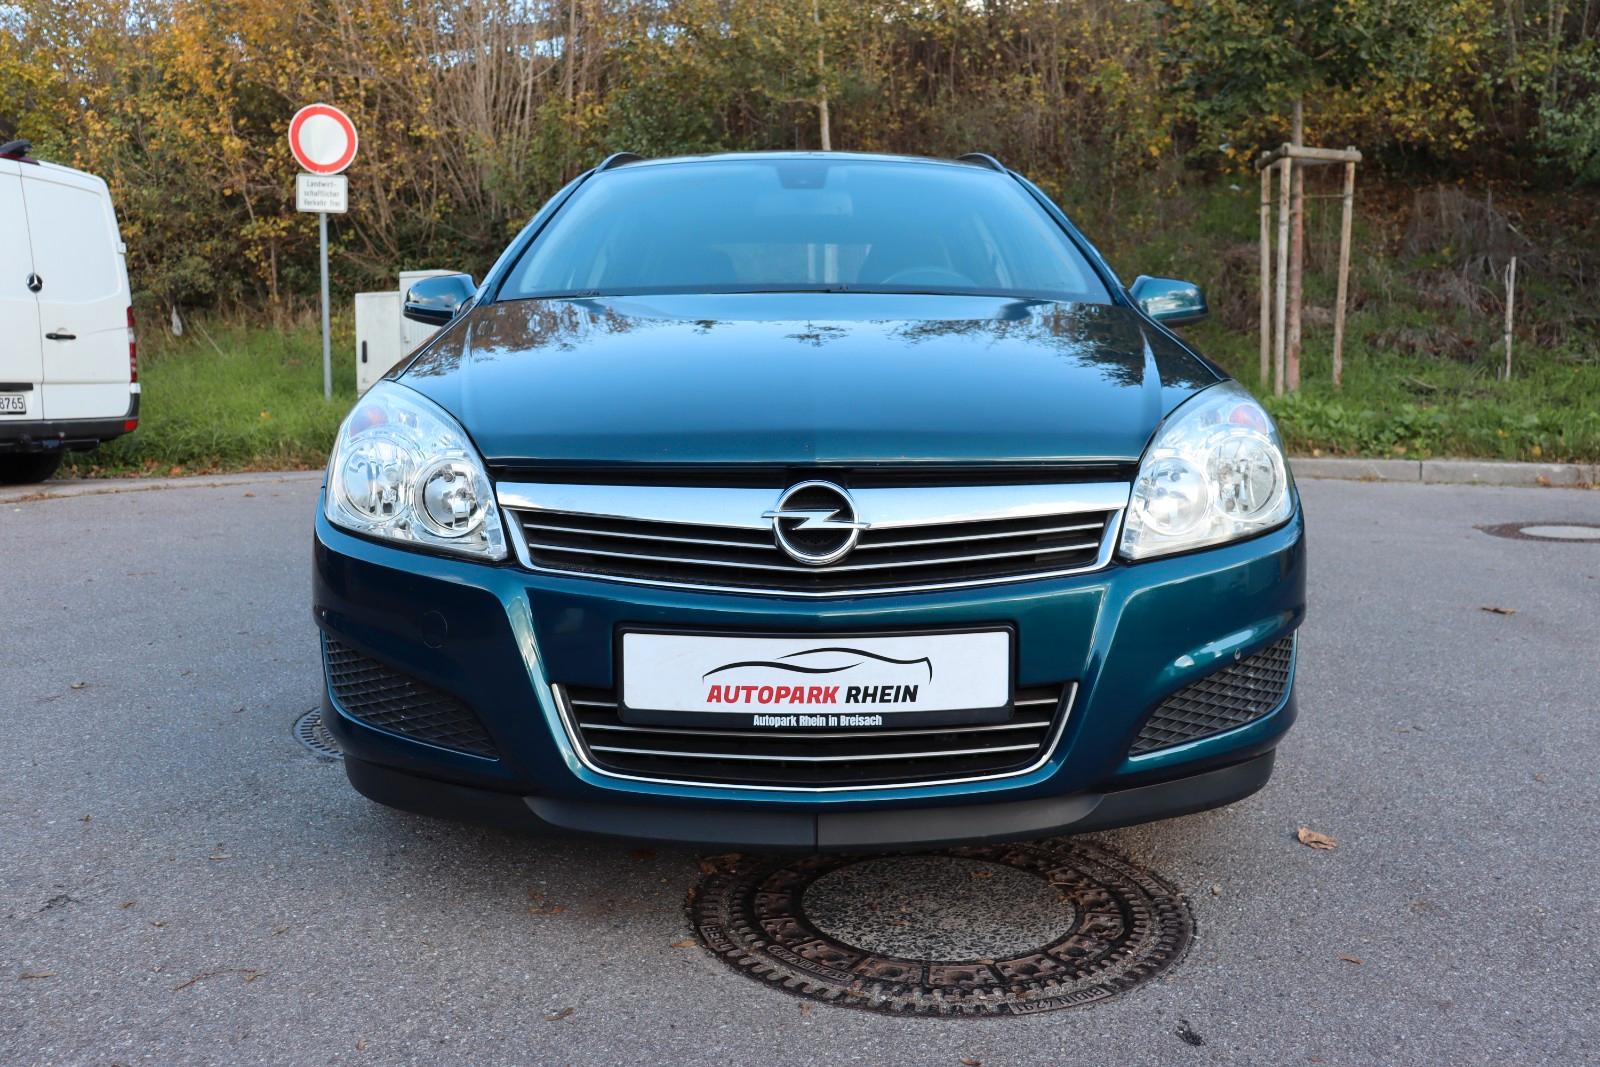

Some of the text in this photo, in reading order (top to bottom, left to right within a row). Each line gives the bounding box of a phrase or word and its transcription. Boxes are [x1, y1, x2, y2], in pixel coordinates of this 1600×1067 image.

[706, 684, 919, 705] AUTOPARK RHEIN
[753, 715, 882, 727] Autopark Rhein in Breisach
